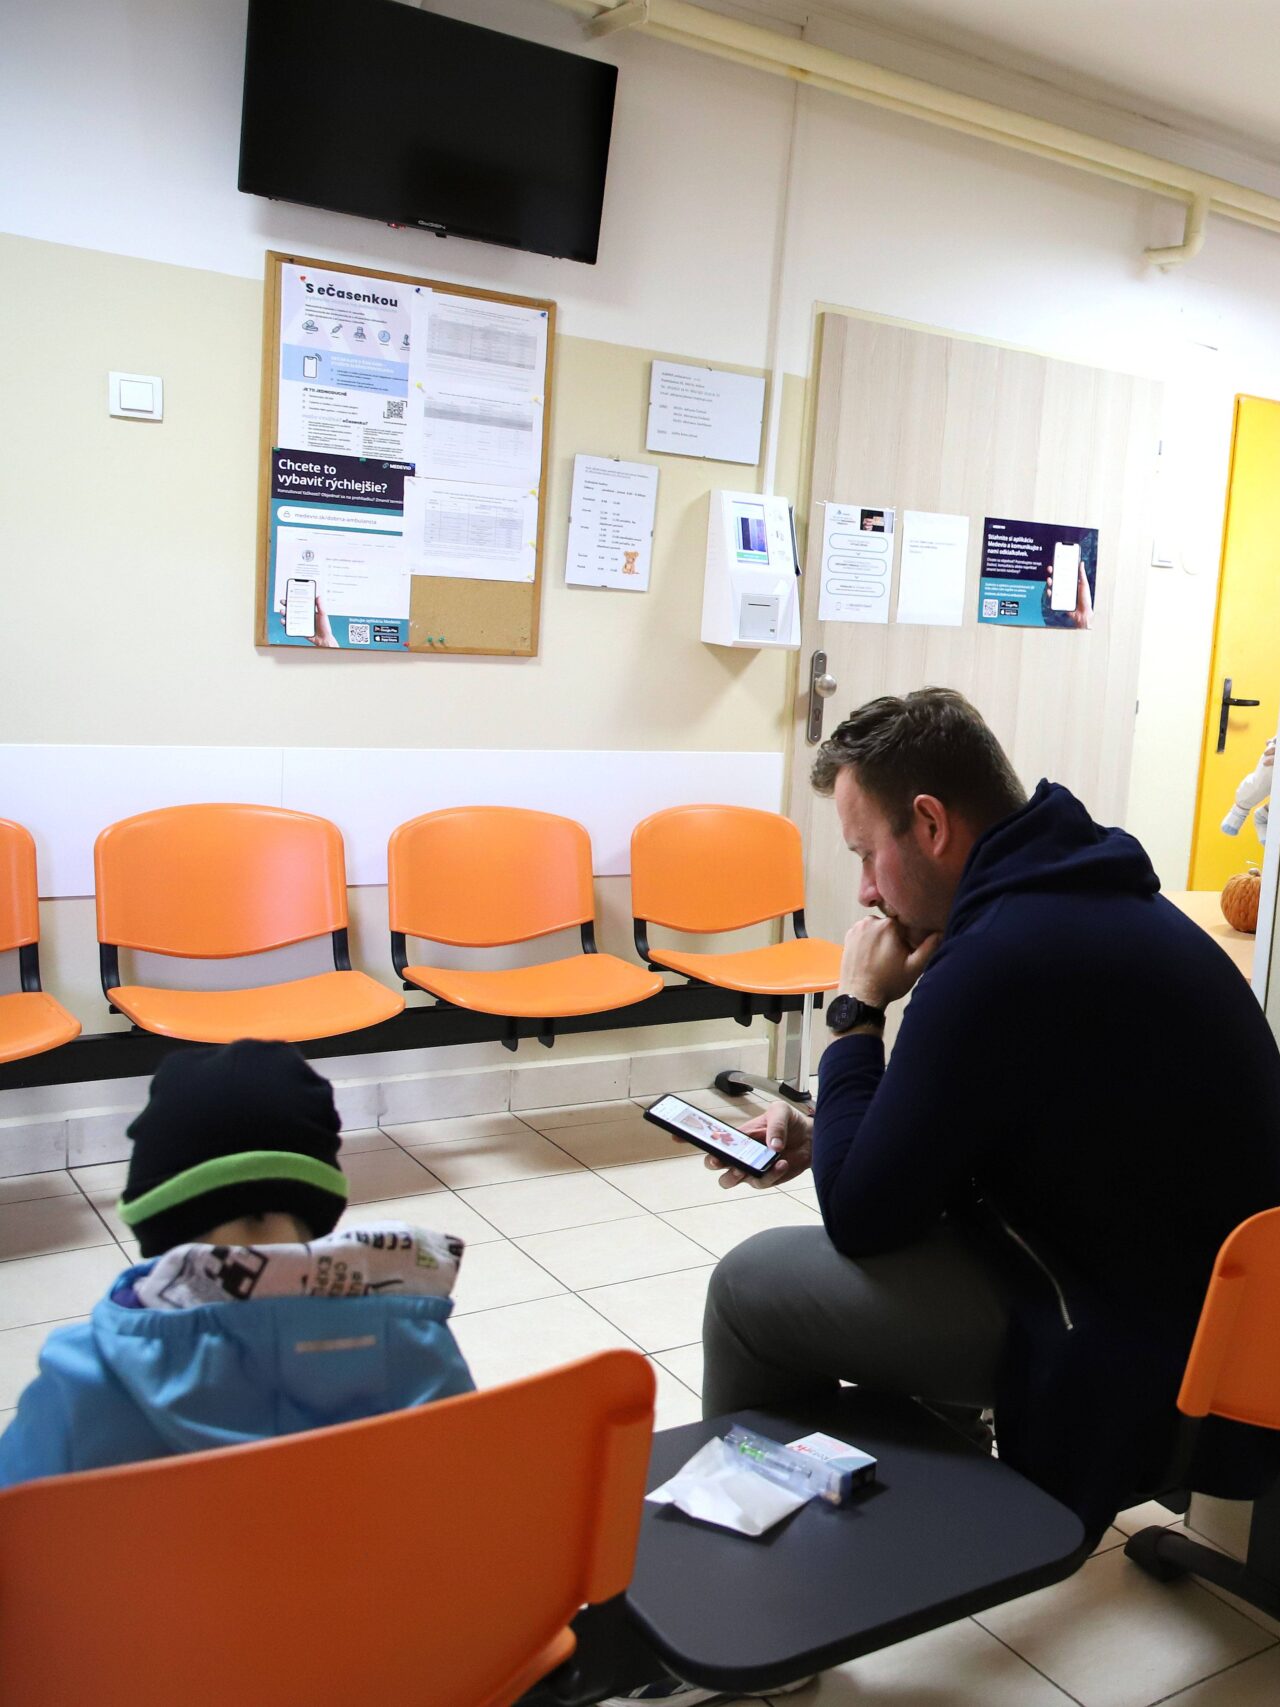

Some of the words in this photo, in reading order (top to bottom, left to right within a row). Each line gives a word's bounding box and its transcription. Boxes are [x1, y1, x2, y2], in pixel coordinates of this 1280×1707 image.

[306, 283, 314, 293] S
[317, 284, 398, 307] eČasenkou
[278, 459, 321, 473] Chcete
[324, 464, 336, 475] to
[278, 473, 324, 487] vybaviť
[325, 477, 388, 493] rýchlejšie?
